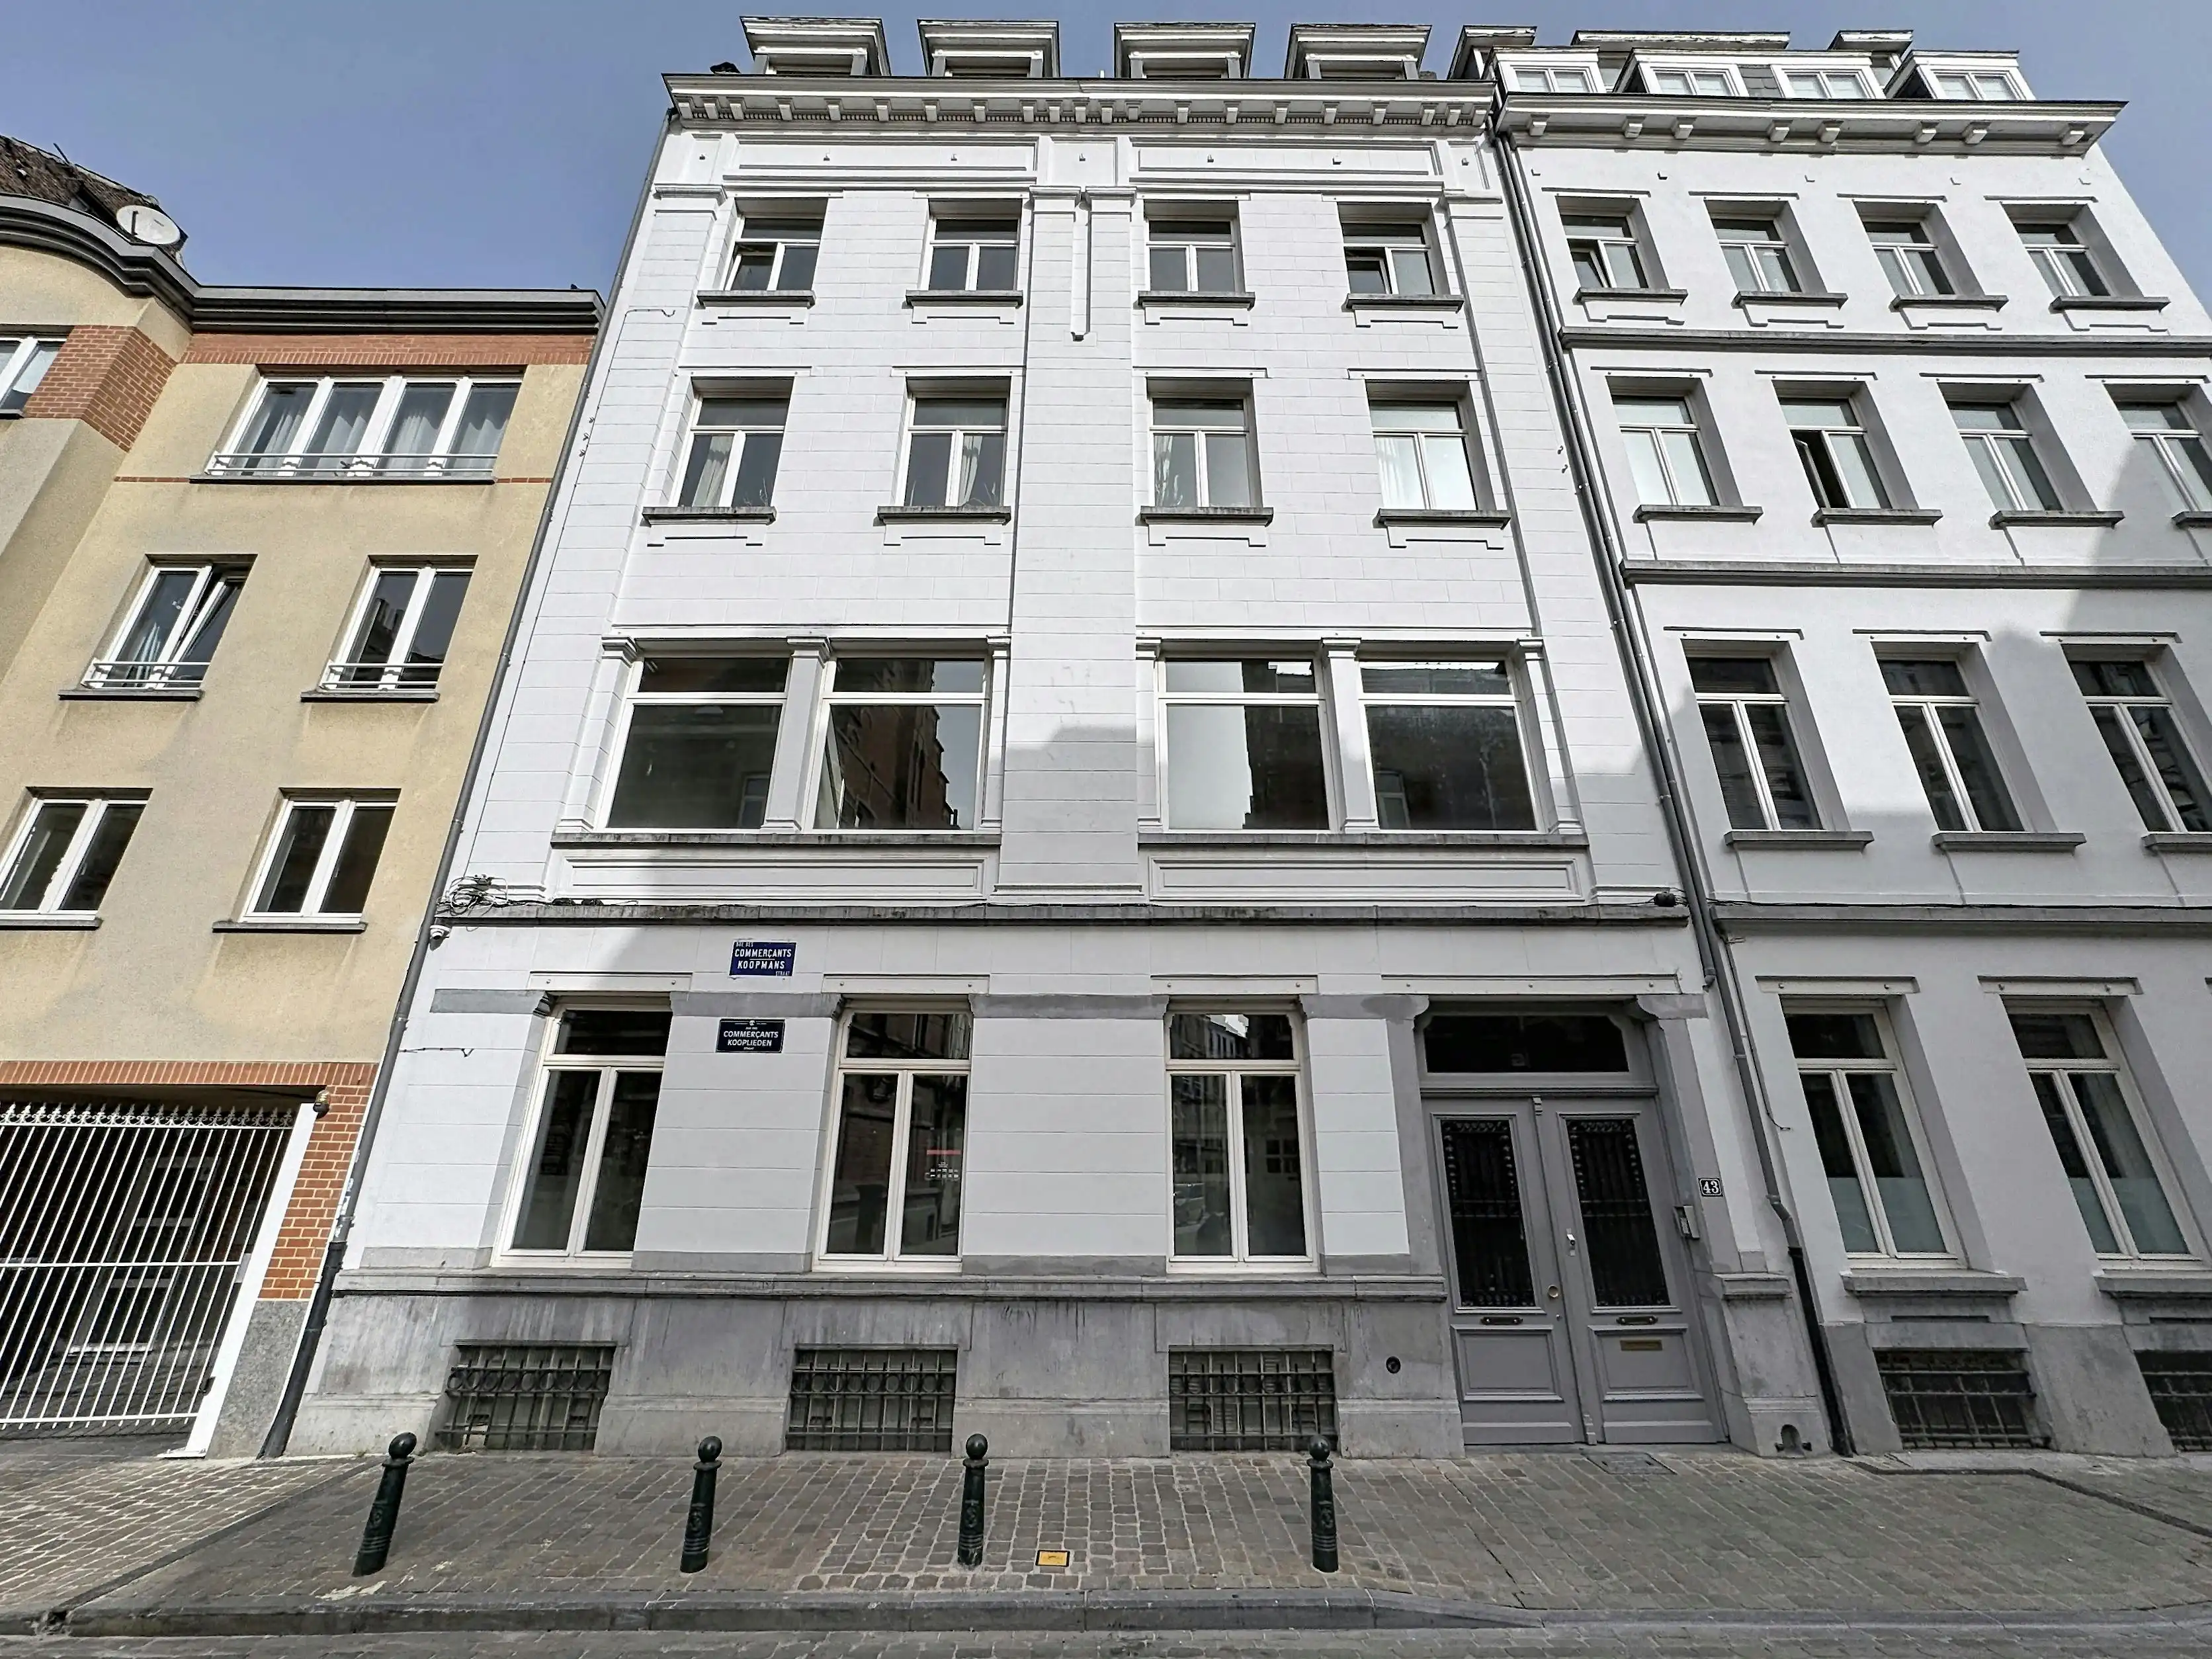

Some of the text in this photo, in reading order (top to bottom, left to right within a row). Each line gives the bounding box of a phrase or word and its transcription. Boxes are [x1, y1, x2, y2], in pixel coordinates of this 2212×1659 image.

[734, 949, 792, 958] COMMERÇANTS
[737, 960, 785, 970] KOOPMANS
[723, 1031, 779, 1039] COMMERÇANTS
[1703, 1181, 1719, 1194] 43
